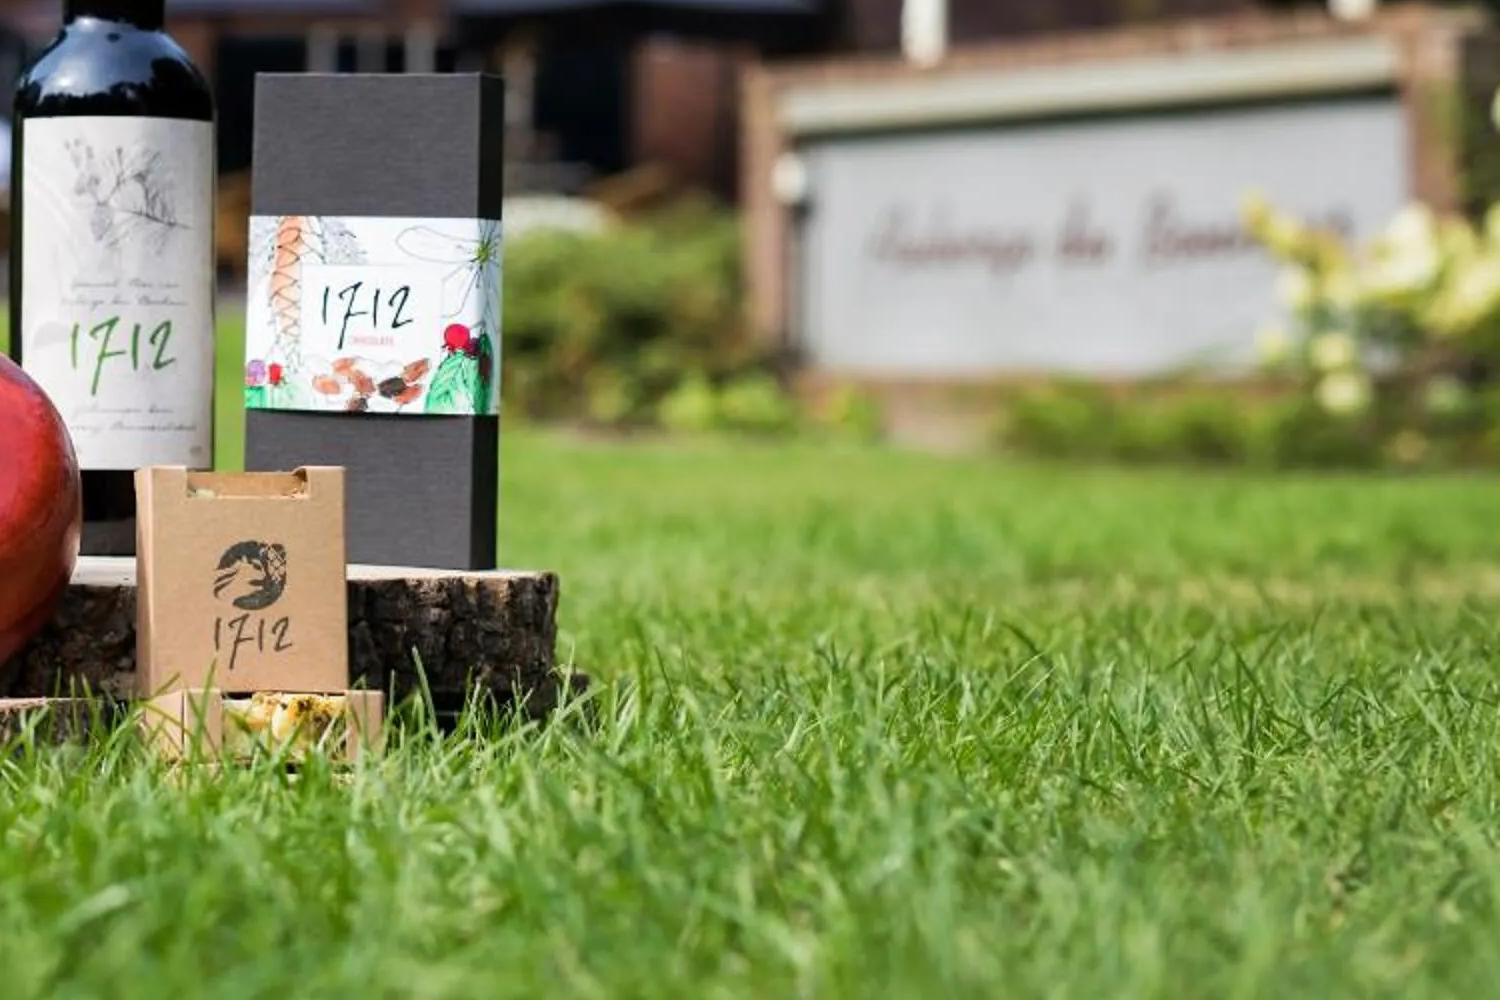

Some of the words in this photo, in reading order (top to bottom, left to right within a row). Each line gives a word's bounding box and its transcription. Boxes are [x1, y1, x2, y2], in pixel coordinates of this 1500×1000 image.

[322, 281, 413, 350] 1712
[71, 315, 176, 396] 1712
[213, 613, 293, 669] 1712
